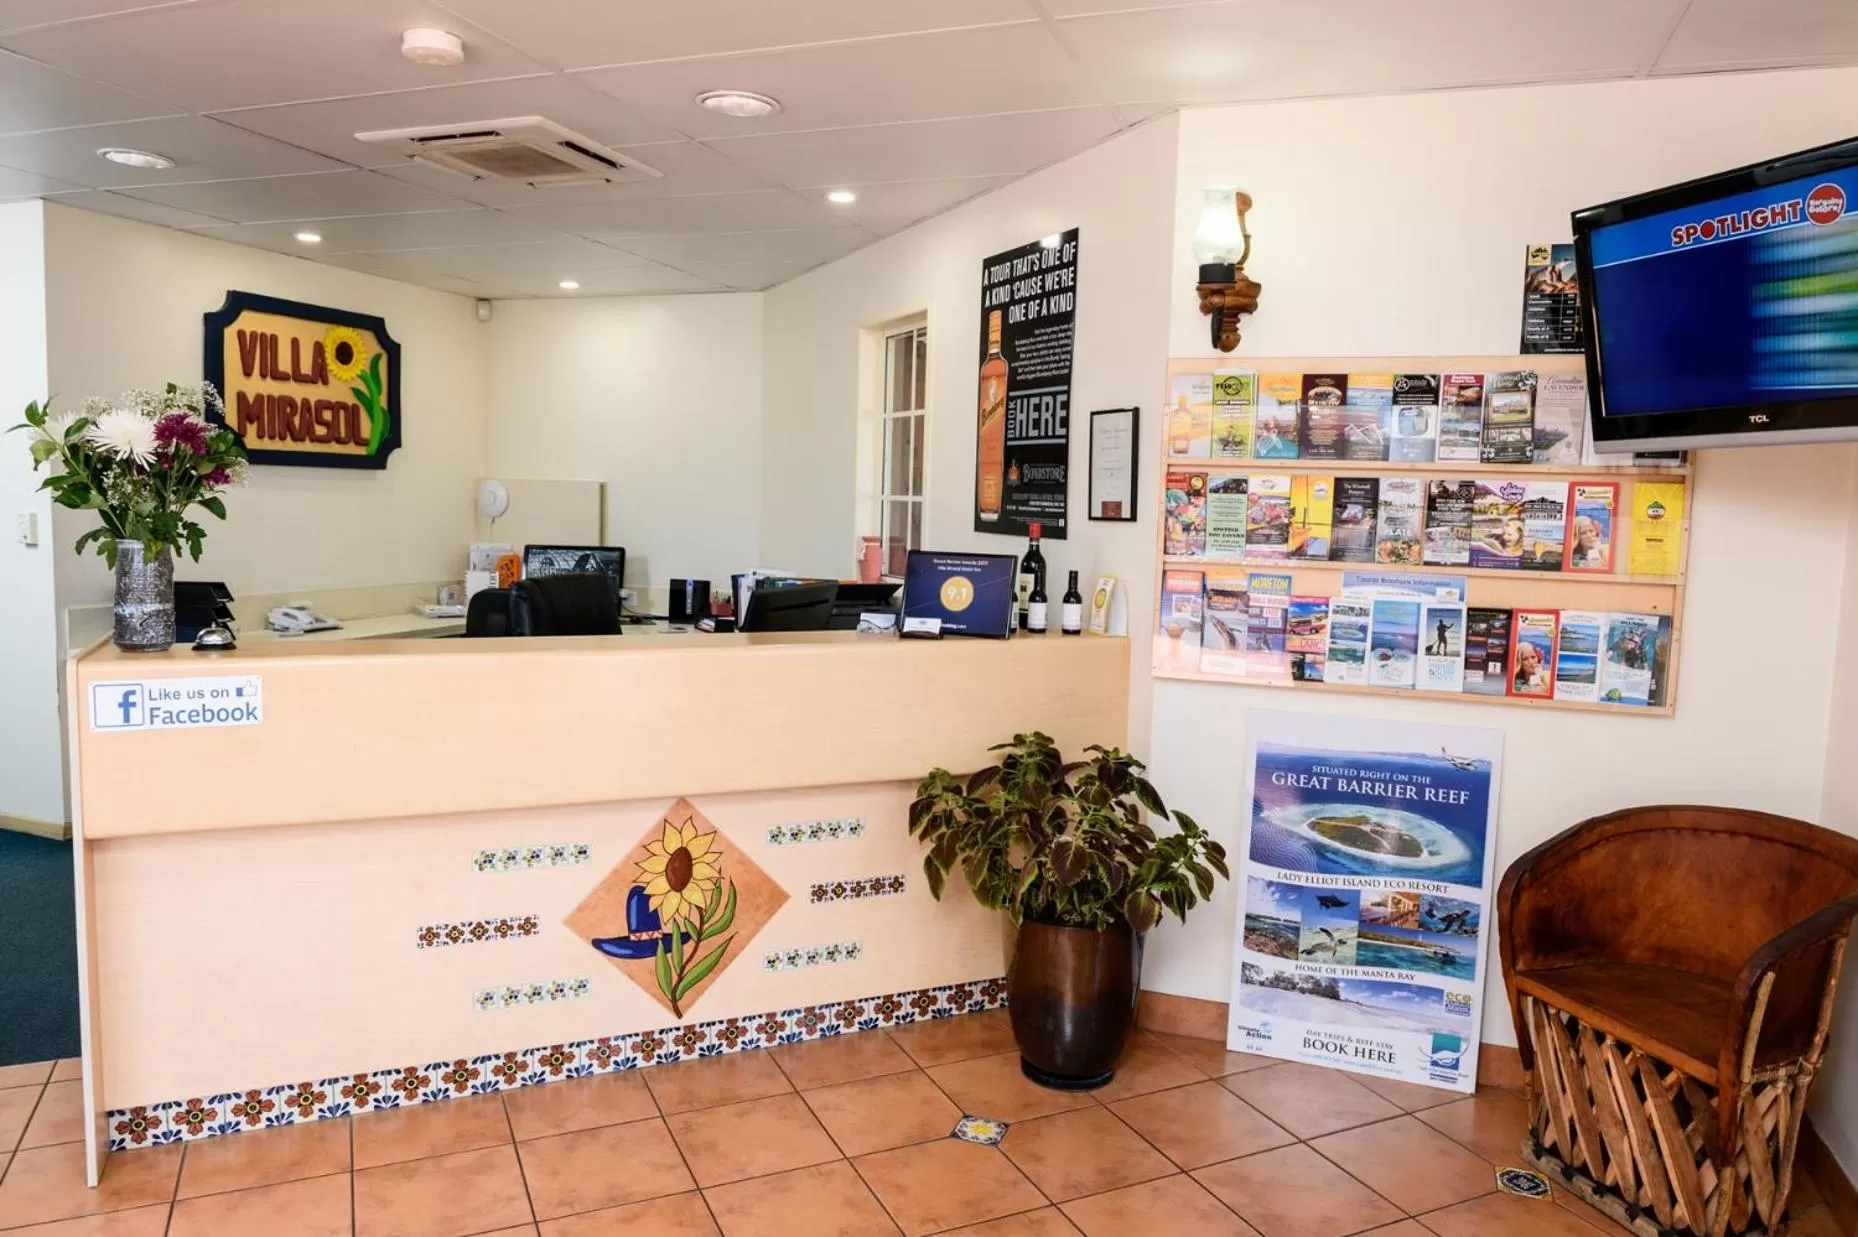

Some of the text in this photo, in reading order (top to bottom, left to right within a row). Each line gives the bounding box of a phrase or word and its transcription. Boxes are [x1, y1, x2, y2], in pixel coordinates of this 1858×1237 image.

[1671, 199, 1802, 247] SPOTLIGHT
[983, 241, 1077, 287] A TOUR THAT'S ONE OF
[984, 290, 991, 308] A
[992, 284, 1011, 306] KIND
[1044, 267, 1075, 292] WE'RE
[1008, 292, 1074, 324] ONE OF A KIND
[236, 328, 329, 386] VILLA
[236, 390, 370, 446] MIRASOL
[1007, 400, 1017, 438] BOOK
[1015, 393, 1068, 438] HERE
[1749, 414, 1770, 424] TCL
[947, 586, 968, 601] 9.1
[148, 688, 230, 701] Like us on
[149, 702, 258, 725] Facebook
[1271, 771, 1470, 805] GREAT BARRIER REEF
[1311, 765, 1431, 785] SITUATED RIGHT ON THE
[1277, 871, 1302, 882] LADY
[1342, 876, 1381, 889] ISLAND
[1384, 880, 1406, 890] ECO
[1409, 882, 1449, 895] RESORT
[1295, 963, 1416, 981] HOME OF THE MANTA RAY
[1302, 1036, 1349, 1056] BOOK
[1354, 1046, 1397, 1065] HERE
